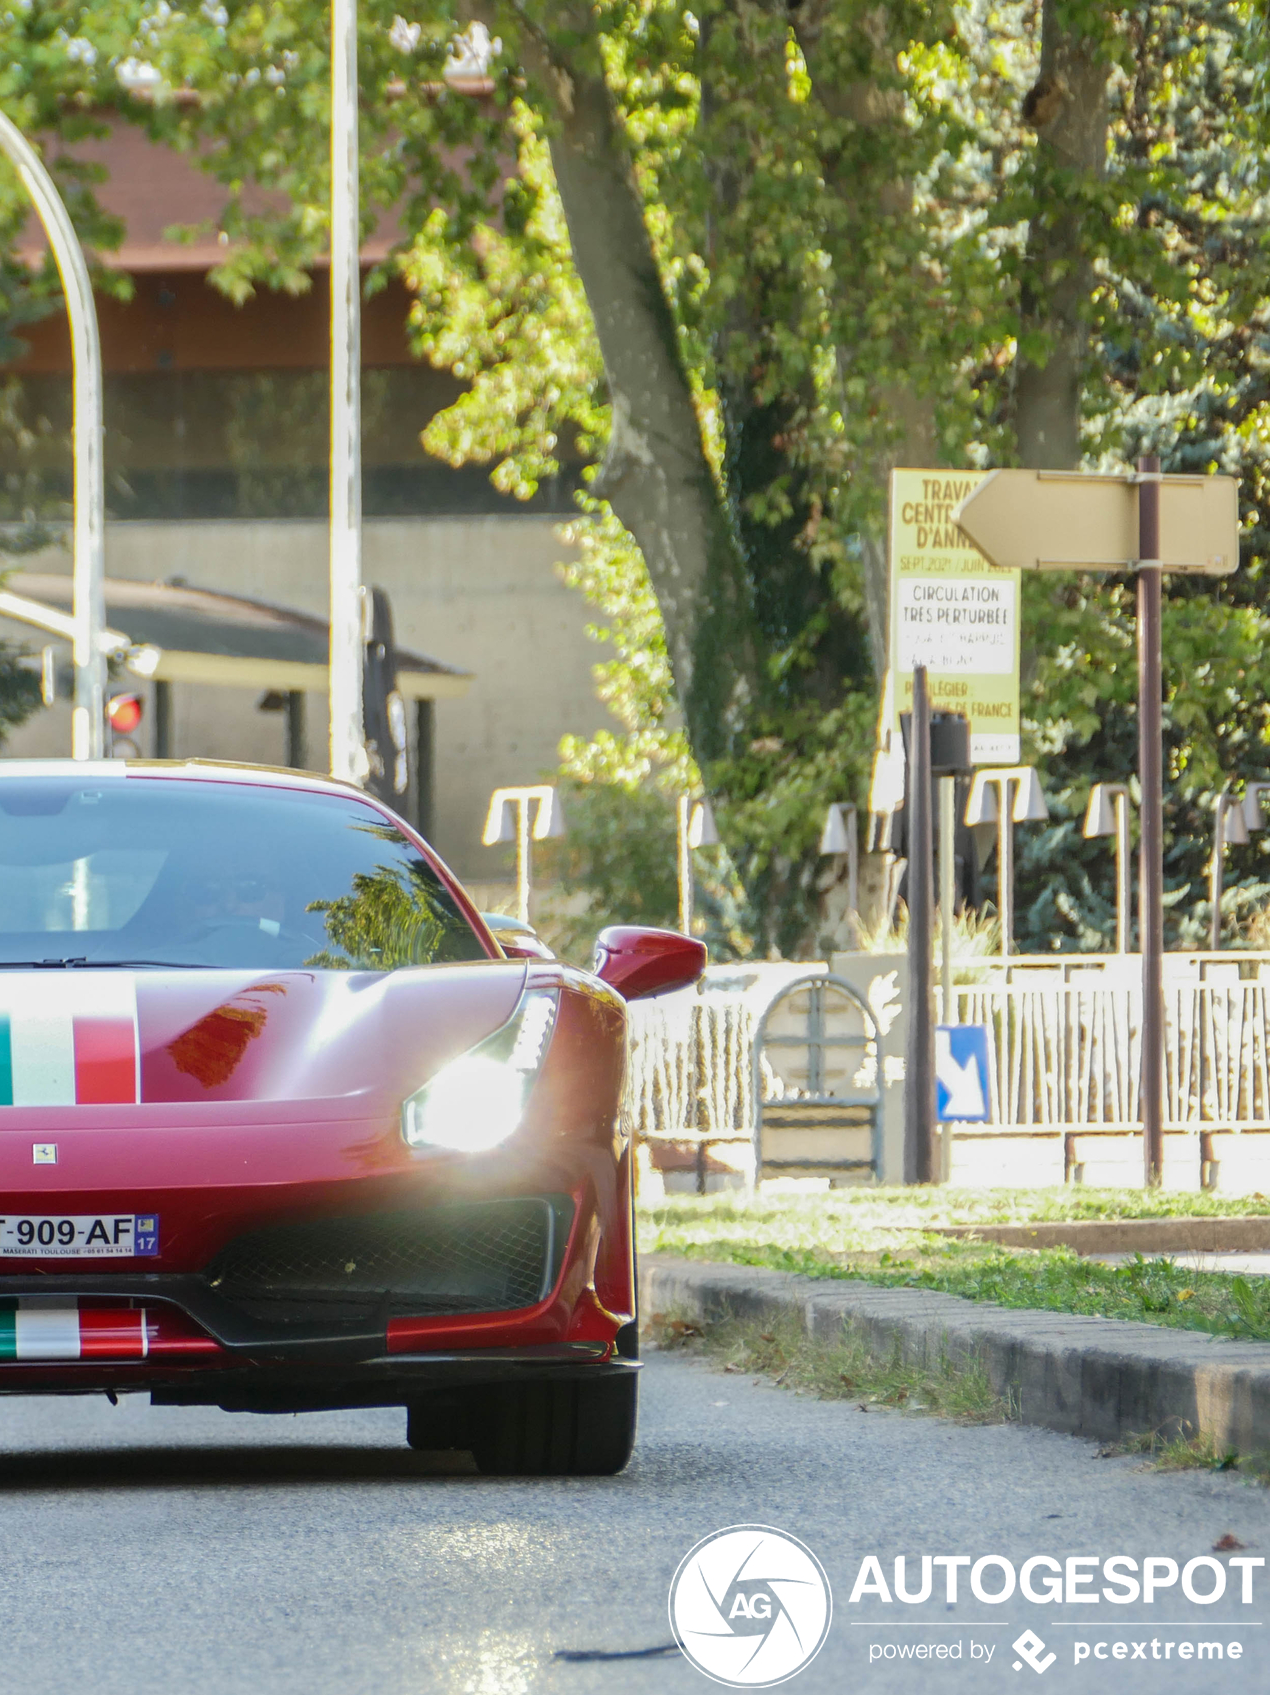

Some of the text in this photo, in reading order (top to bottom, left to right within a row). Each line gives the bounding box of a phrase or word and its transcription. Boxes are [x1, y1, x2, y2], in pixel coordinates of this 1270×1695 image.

[922, 479, 980, 501] TRAVA
[917, 526, 977, 550] D'ANN
[961, 557, 985, 572] JUIN
[913, 585, 1000, 602] CIRCULATION
[971, 702, 1013, 718] FRANCE
[3, 1247, 37, 1255] MASERATI
[40, 1247, 81, 1255] TOULOUSE
[137, 1237, 156, 1250] 17
